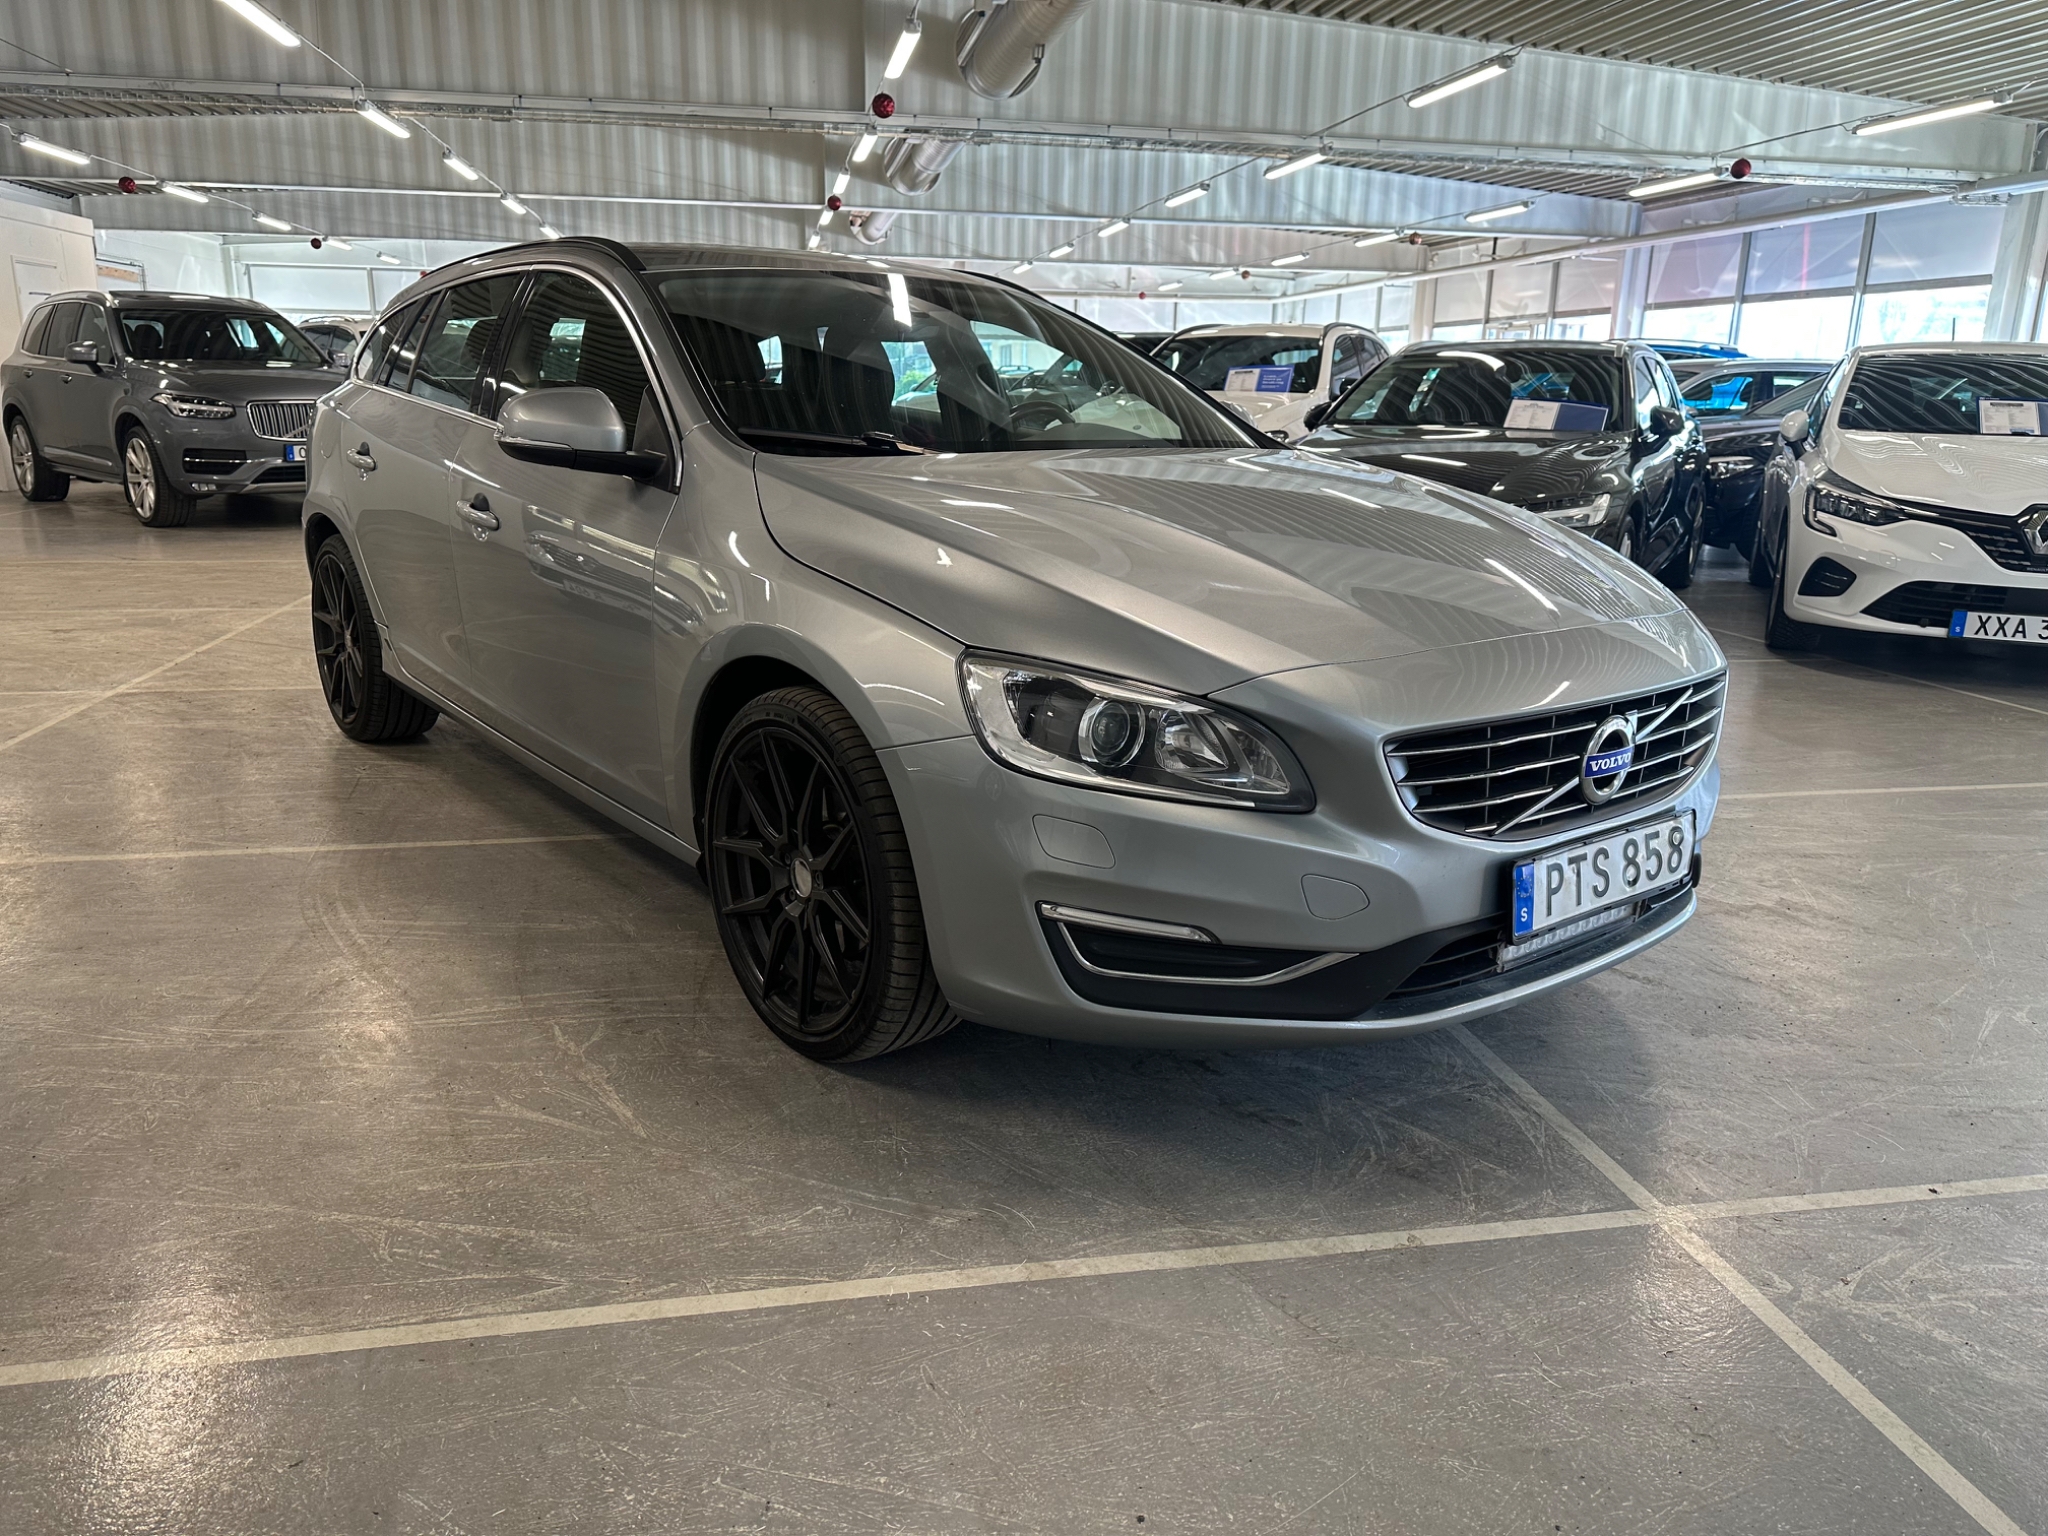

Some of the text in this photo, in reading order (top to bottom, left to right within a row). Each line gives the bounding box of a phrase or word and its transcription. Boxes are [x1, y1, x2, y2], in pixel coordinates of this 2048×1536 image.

[1974, 615, 2027, 639] XXA
[1590, 752, 1631, 772] VOLVO
[1546, 826, 1685, 917] PTS 858
[1520, 907, 1528, 922] S
